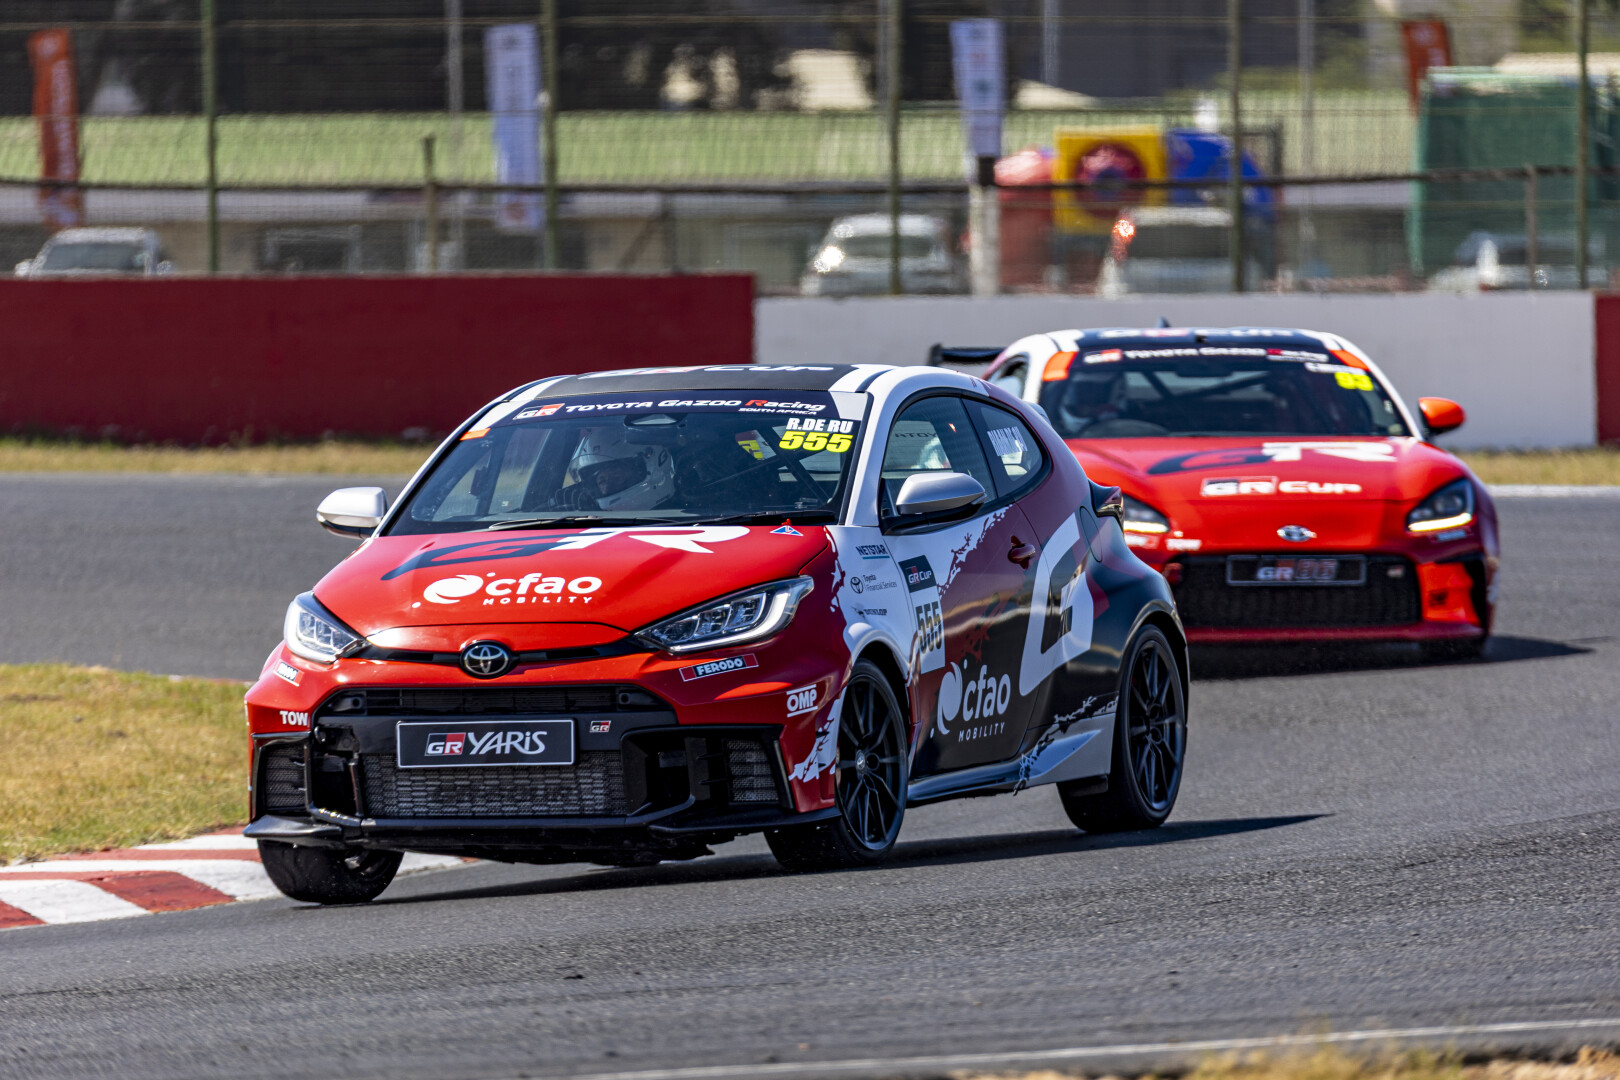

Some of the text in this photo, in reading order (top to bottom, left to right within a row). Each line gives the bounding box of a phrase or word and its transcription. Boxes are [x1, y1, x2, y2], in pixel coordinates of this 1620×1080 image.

[514, 399, 826, 420] GR TOYOTA GAZOO Racing
[778, 431, 853, 453] 555
[856, 544, 888, 556] NETSTAR
[485, 572, 602, 596] cfao
[482, 596, 592, 605] MOBILITY
[915, 601, 943, 655] 555
[697, 656, 744, 676] FERODO
[786, 688, 818, 712] OMP
[962, 664, 1011, 722] cfao
[279, 710, 309, 727] TOW
[958, 722, 1005, 743] MOBILITY
[426, 741, 465, 755] GR
